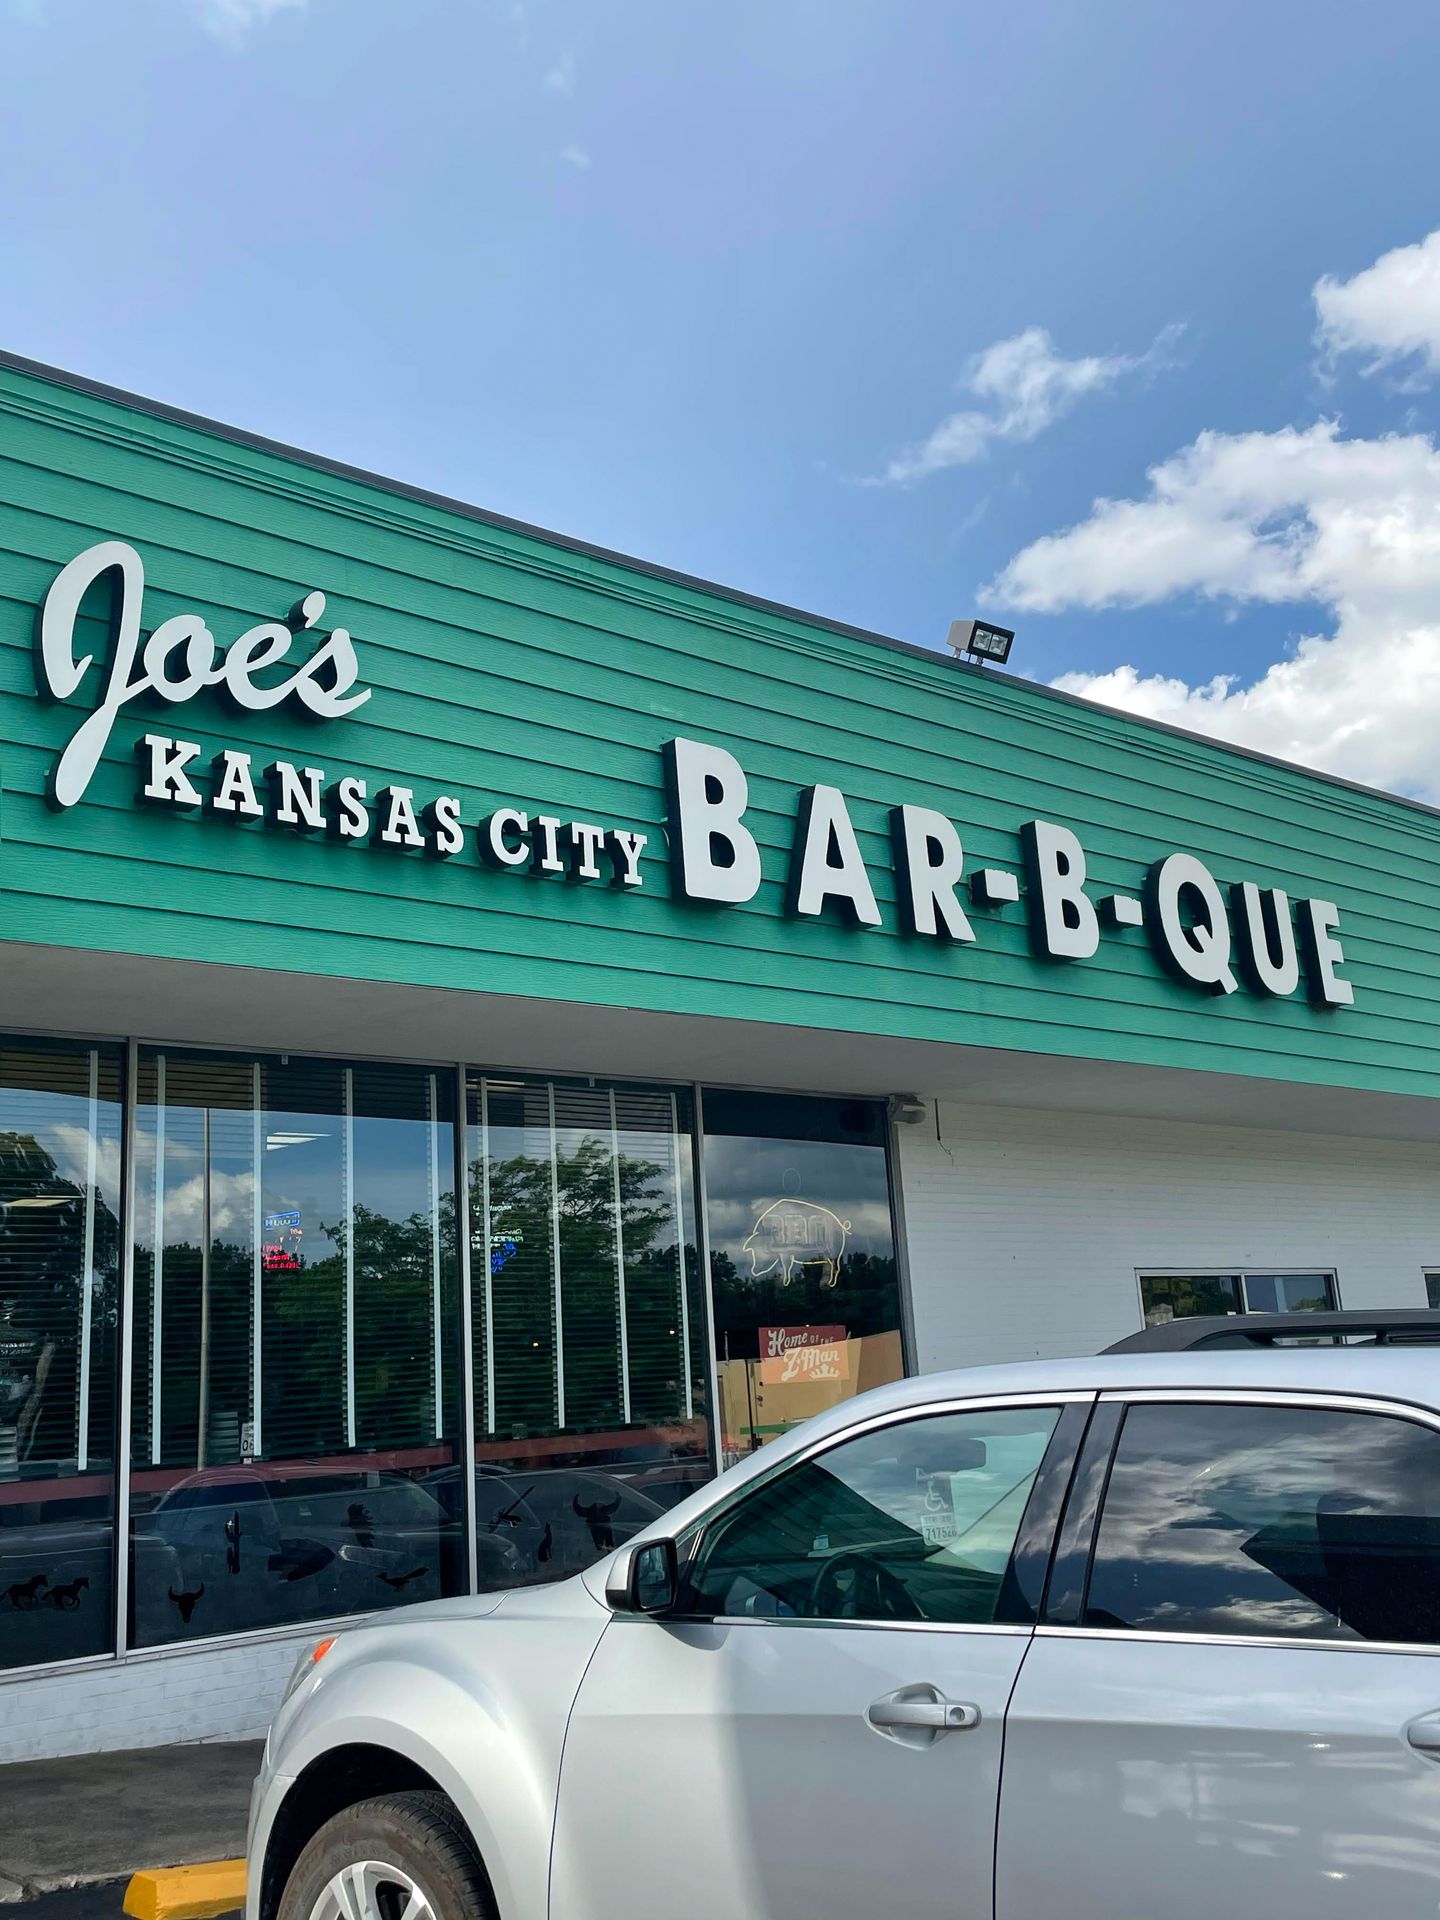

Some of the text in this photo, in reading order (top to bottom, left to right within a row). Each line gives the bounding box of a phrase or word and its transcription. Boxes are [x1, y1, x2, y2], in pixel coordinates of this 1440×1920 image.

[41, 541, 372, 806] Joe's
[142, 733, 648, 888] KANSAS CITY
[673, 737, 1354, 1006] BAR-B-QUE
[767, 1328, 808, 1357] Home
